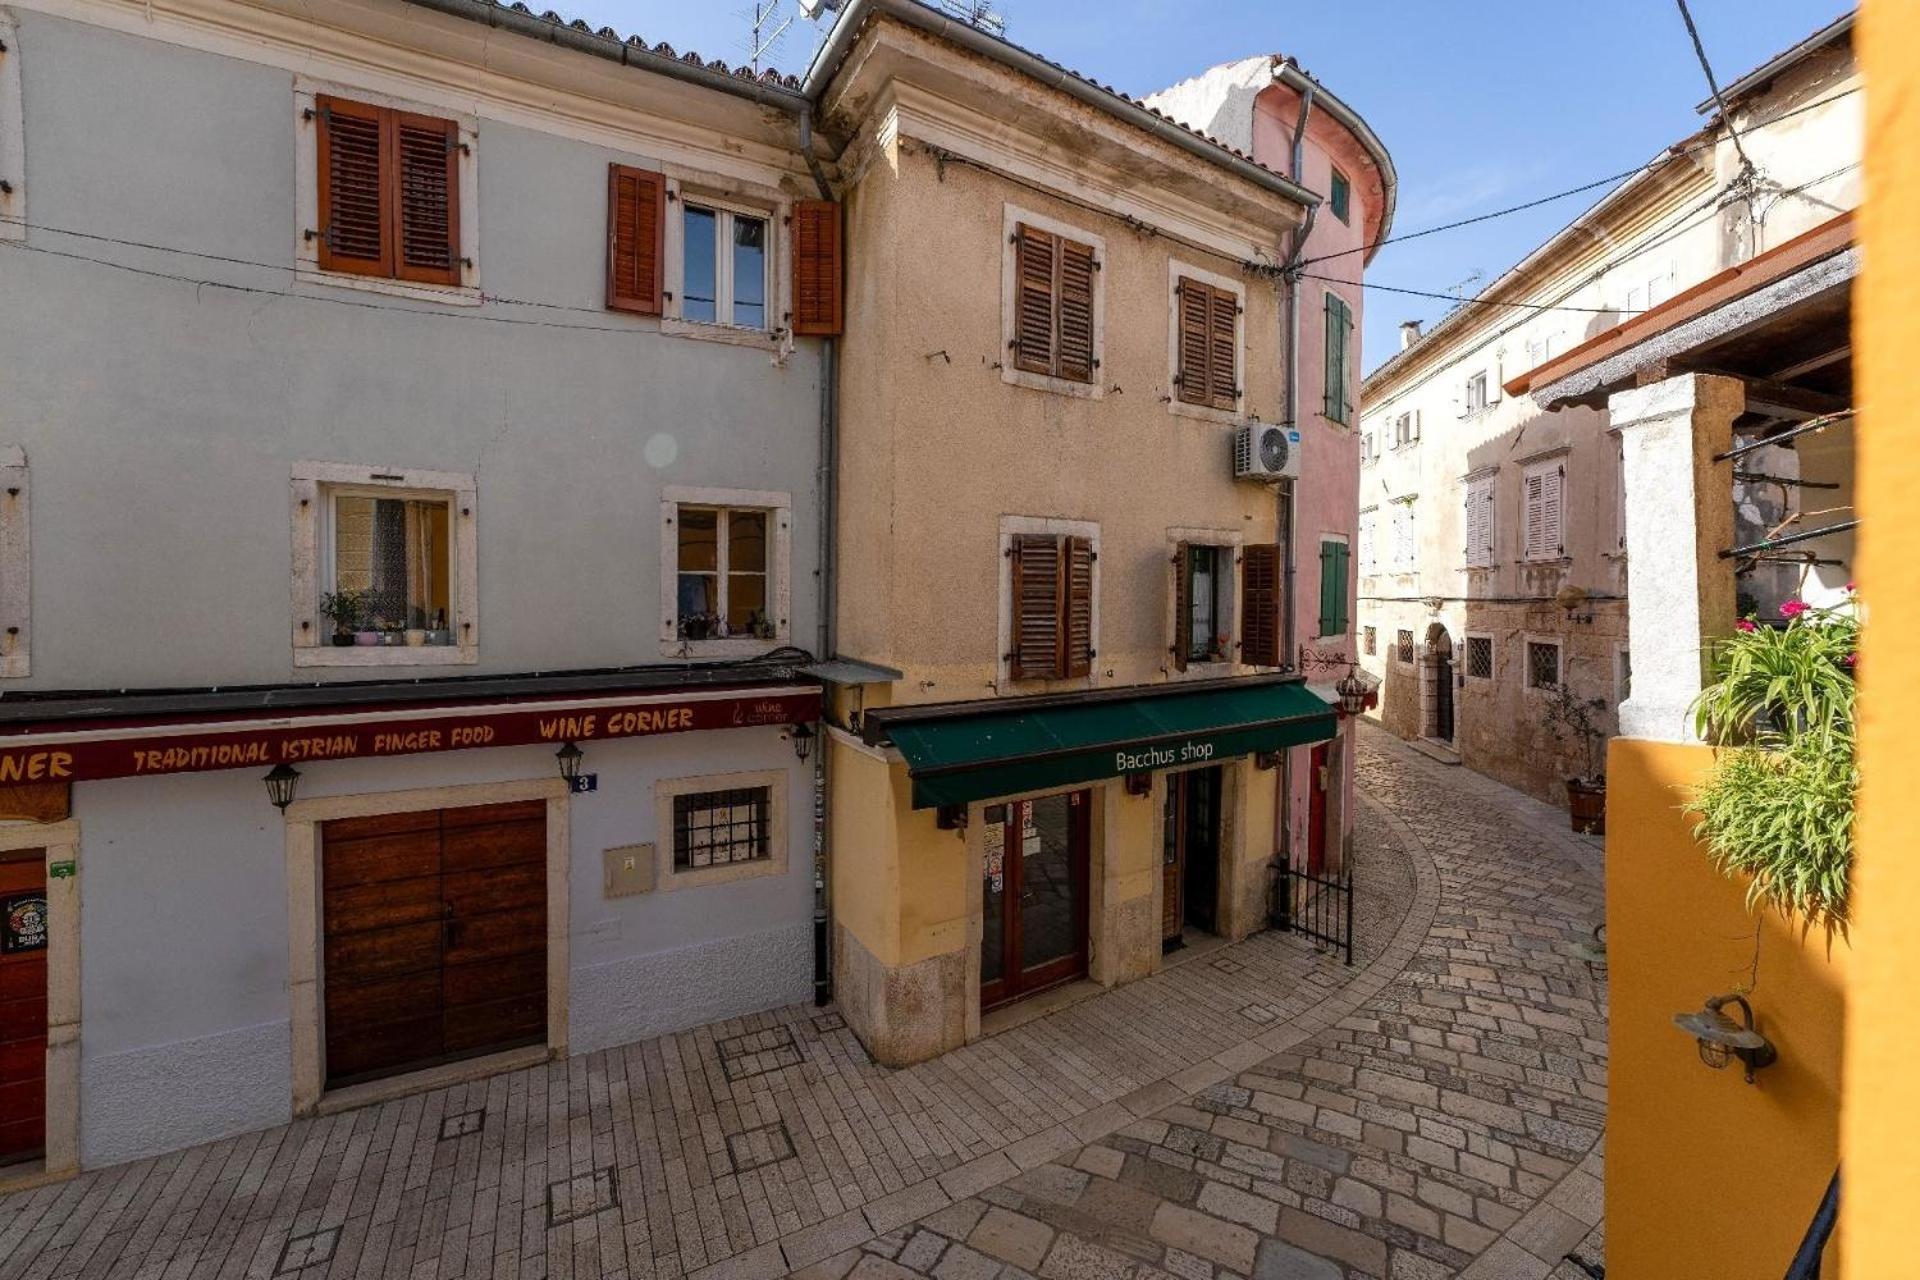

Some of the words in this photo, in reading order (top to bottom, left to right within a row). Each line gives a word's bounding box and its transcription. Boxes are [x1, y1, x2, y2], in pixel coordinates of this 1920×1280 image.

[539, 717, 597, 738] WINE
[607, 709, 694, 733] CORNER
[134, 743, 268, 771] TRADITIONAL
[282, 737, 357, 758] ISTRIAN
[375, 731, 441, 751] FINGER
[451, 725, 495, 746] FOOD
[1116, 747, 1175, 771] Bacchus
[1181, 741, 1213, 760] shop
[579, 776, 588, 790] 3
